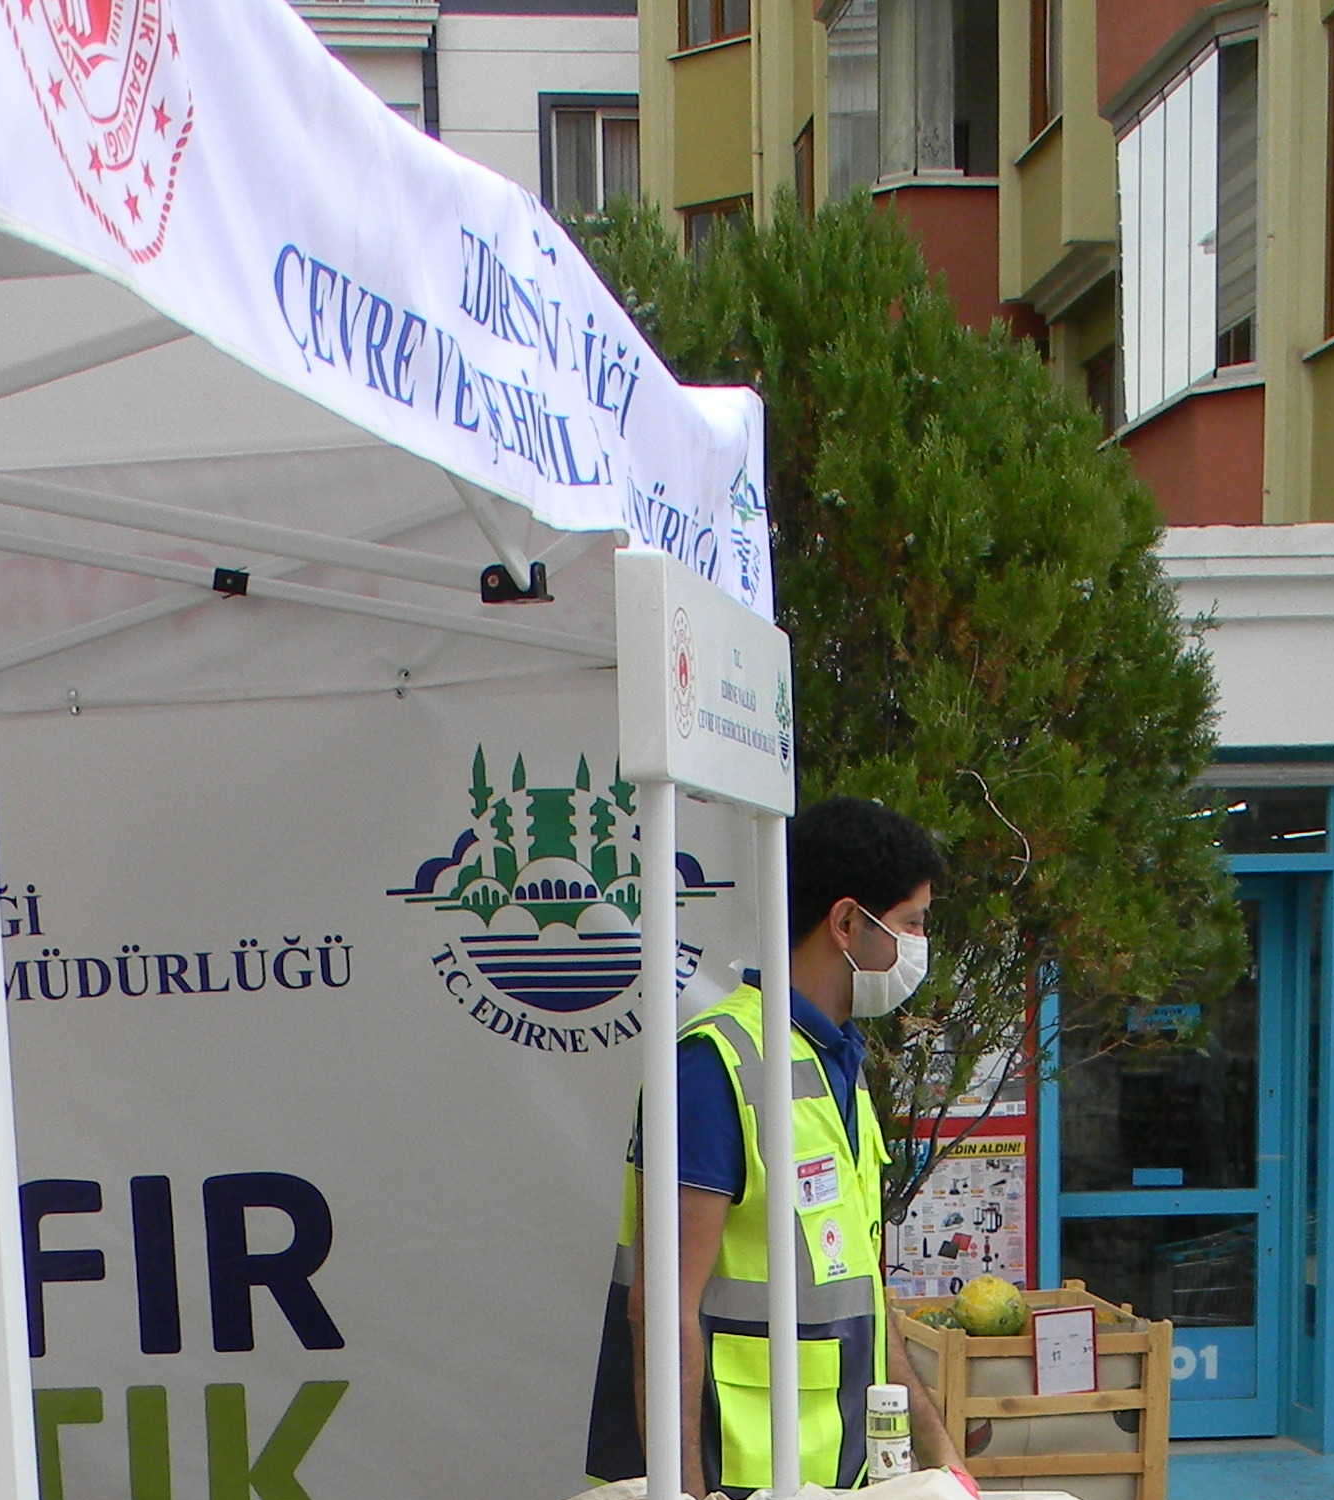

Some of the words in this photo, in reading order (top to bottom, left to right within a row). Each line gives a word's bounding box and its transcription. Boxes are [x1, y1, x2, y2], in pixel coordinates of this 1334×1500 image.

[273, 243, 427, 409] ÇEVRE
[431, 943, 472, 1005] T.C.
[468, 994, 589, 1054] EDİRNE
[979, 1141, 1022, 1154] ALDIN!
